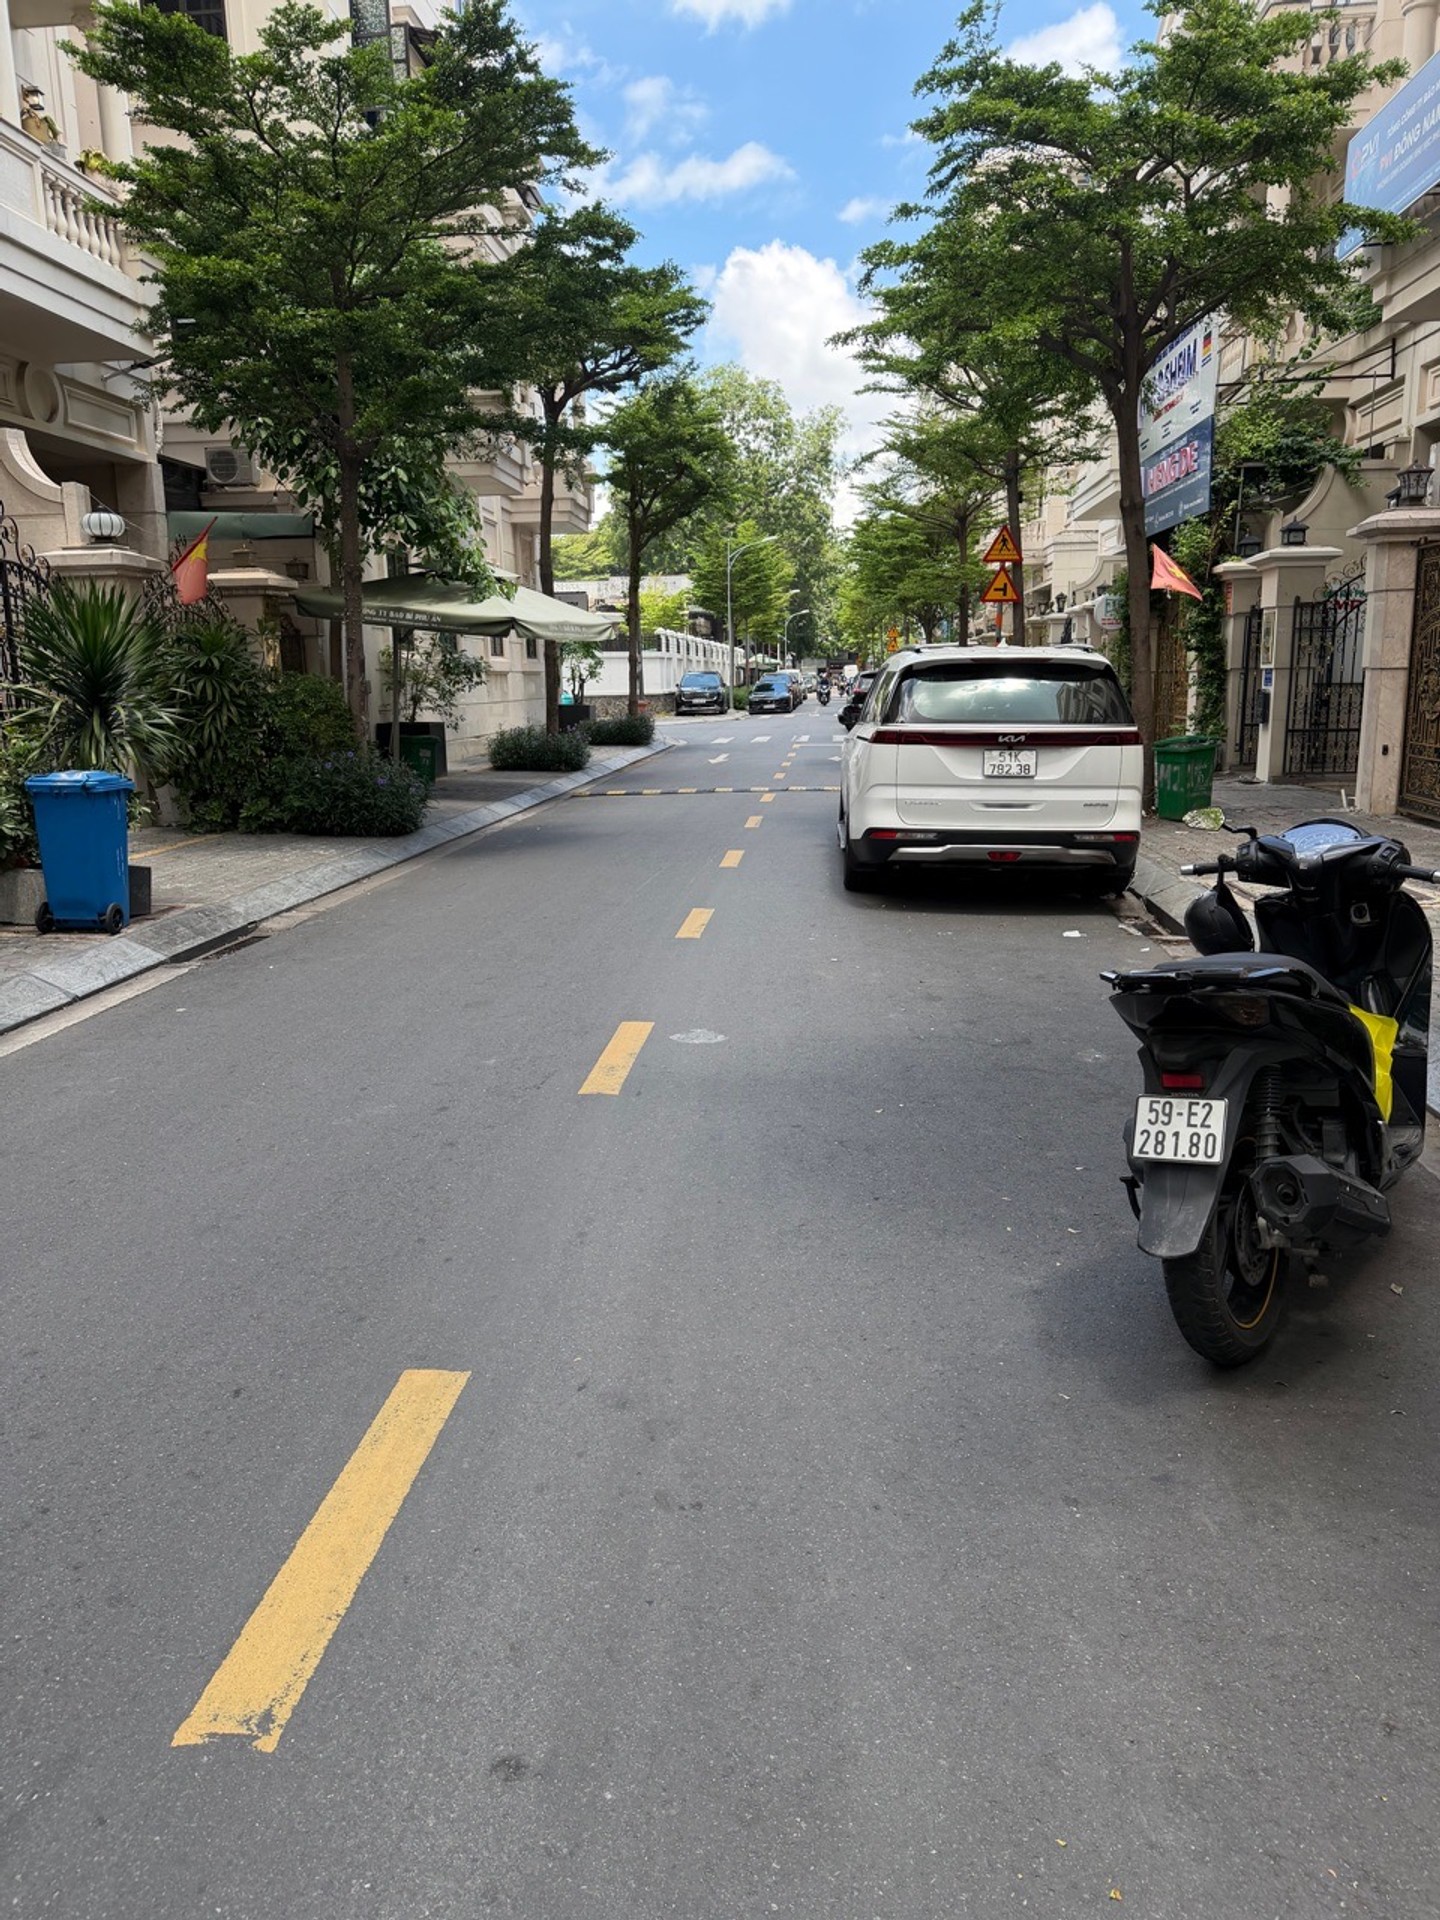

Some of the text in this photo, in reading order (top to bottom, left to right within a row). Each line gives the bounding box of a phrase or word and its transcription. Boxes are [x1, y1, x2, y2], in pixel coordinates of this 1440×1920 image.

[998, 734, 1026, 743] KIA
[998, 751, 1022, 763] 51K
[989, 763, 1031, 776] 782.38
[1147, 1099, 1214, 1129] 59-E2
[1138, 1129, 1217, 1159] 281.80
